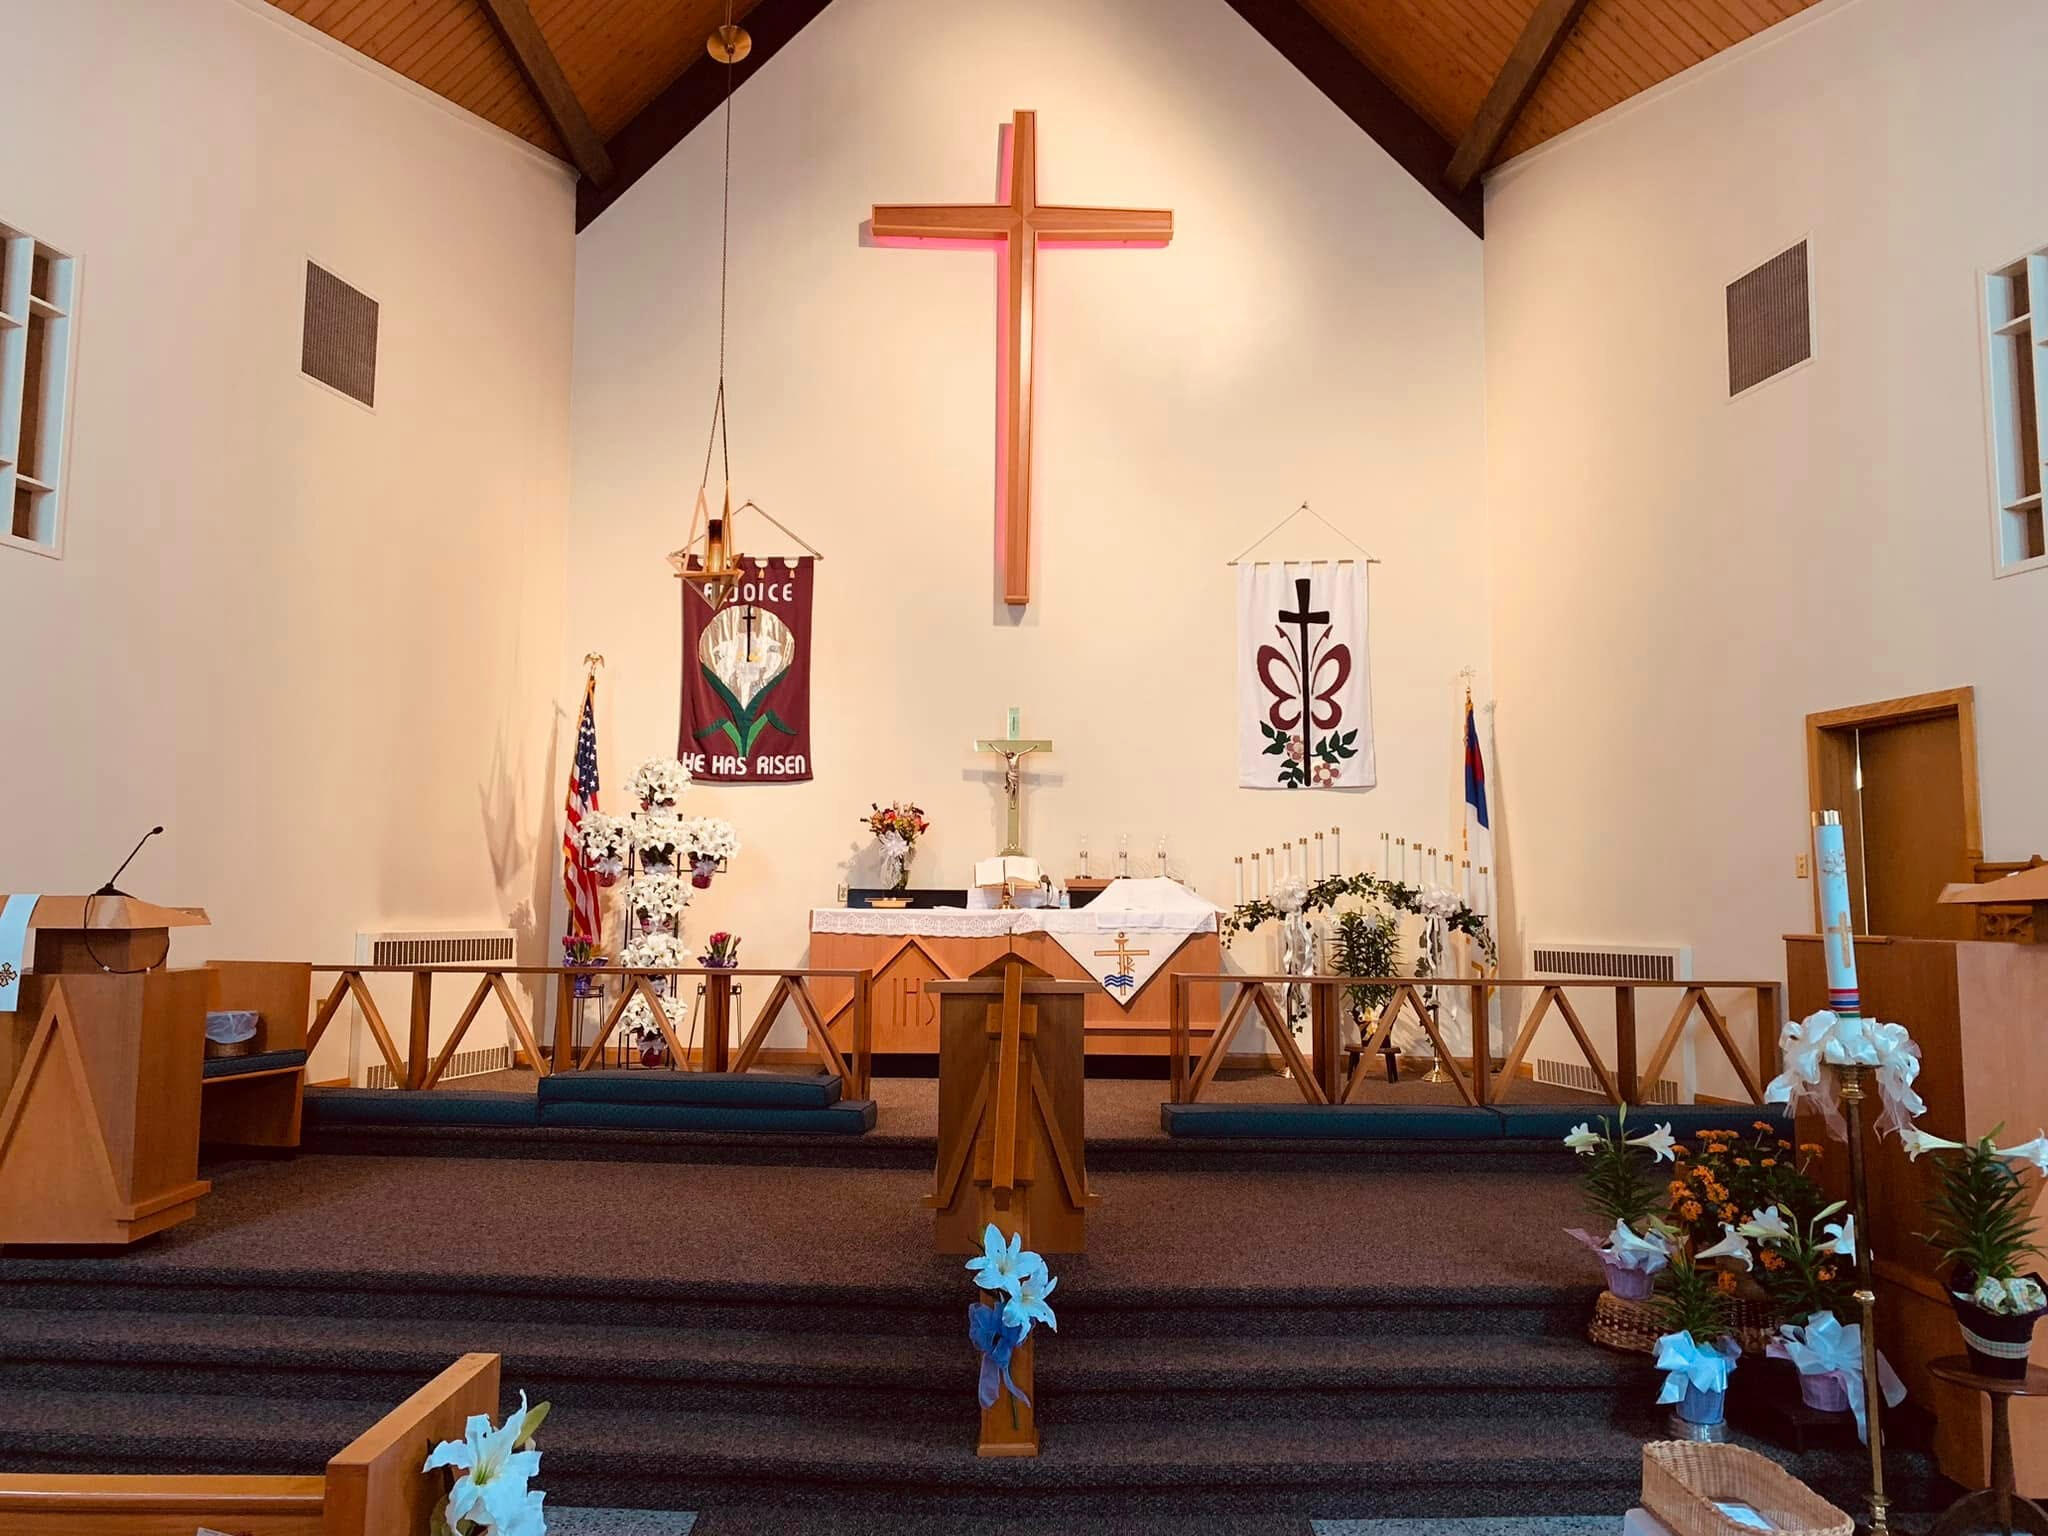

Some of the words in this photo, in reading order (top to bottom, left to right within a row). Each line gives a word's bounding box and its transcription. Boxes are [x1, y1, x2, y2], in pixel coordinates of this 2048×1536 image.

[682, 751, 706, 773] HE
[711, 755, 748, 776] HAS
[756, 754, 807, 776] RISEN
